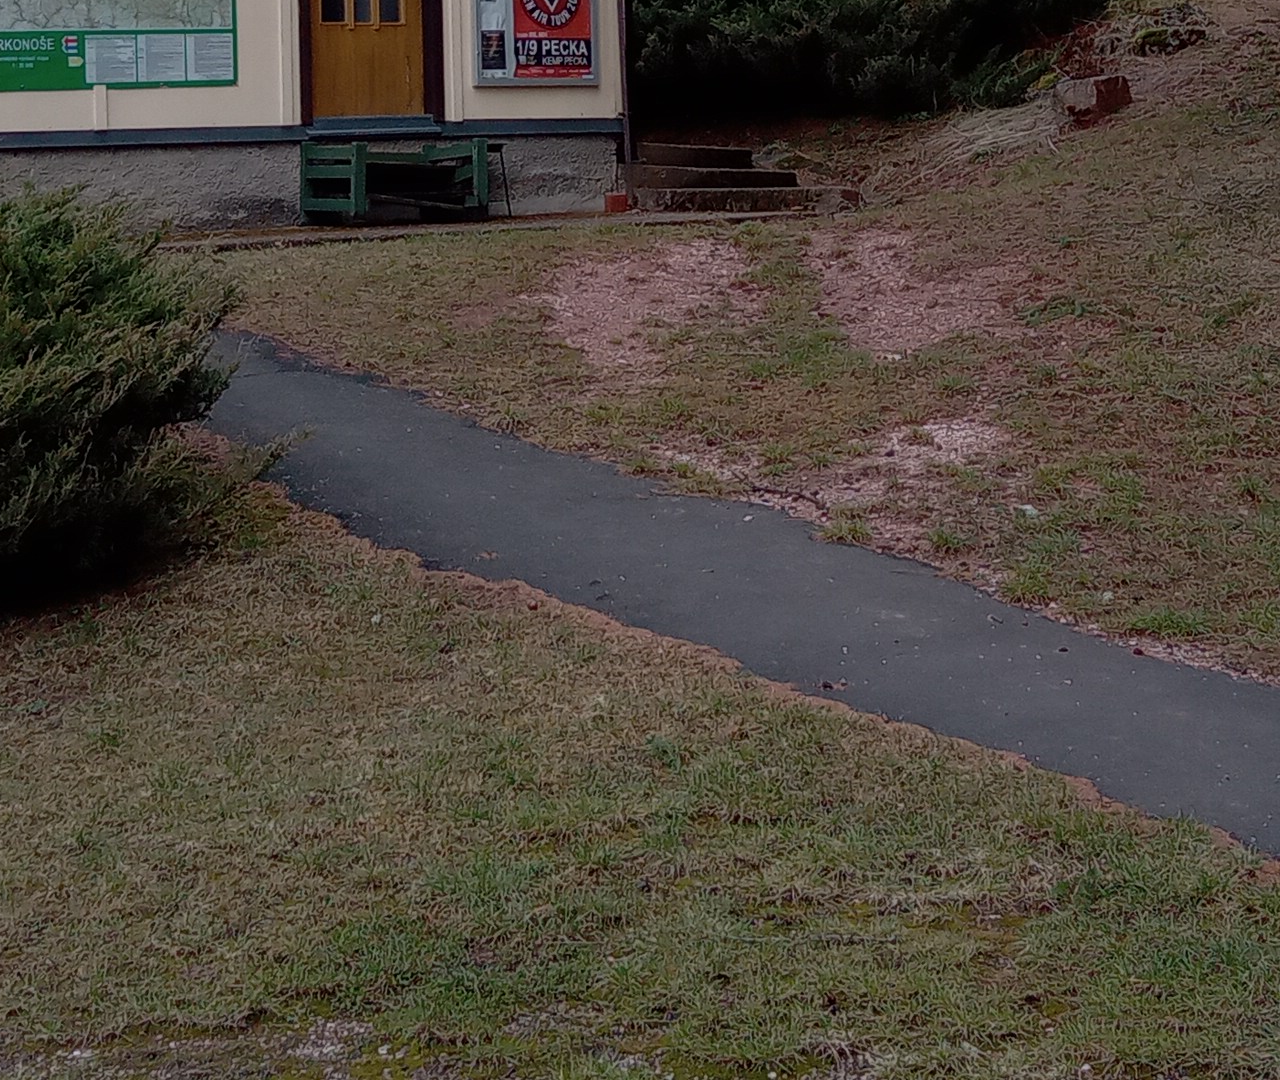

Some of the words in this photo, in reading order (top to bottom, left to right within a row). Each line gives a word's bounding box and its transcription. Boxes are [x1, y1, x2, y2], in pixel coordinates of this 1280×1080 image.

[531, 9, 548, 25] AIR
[550, 9, 571, 26] TOUR
[516, 39, 538, 56] 1/9
[541, 39, 588, 56] PECKA
[542, 56, 563, 65] KEMP
[564, 56, 588, 65] PECKA
